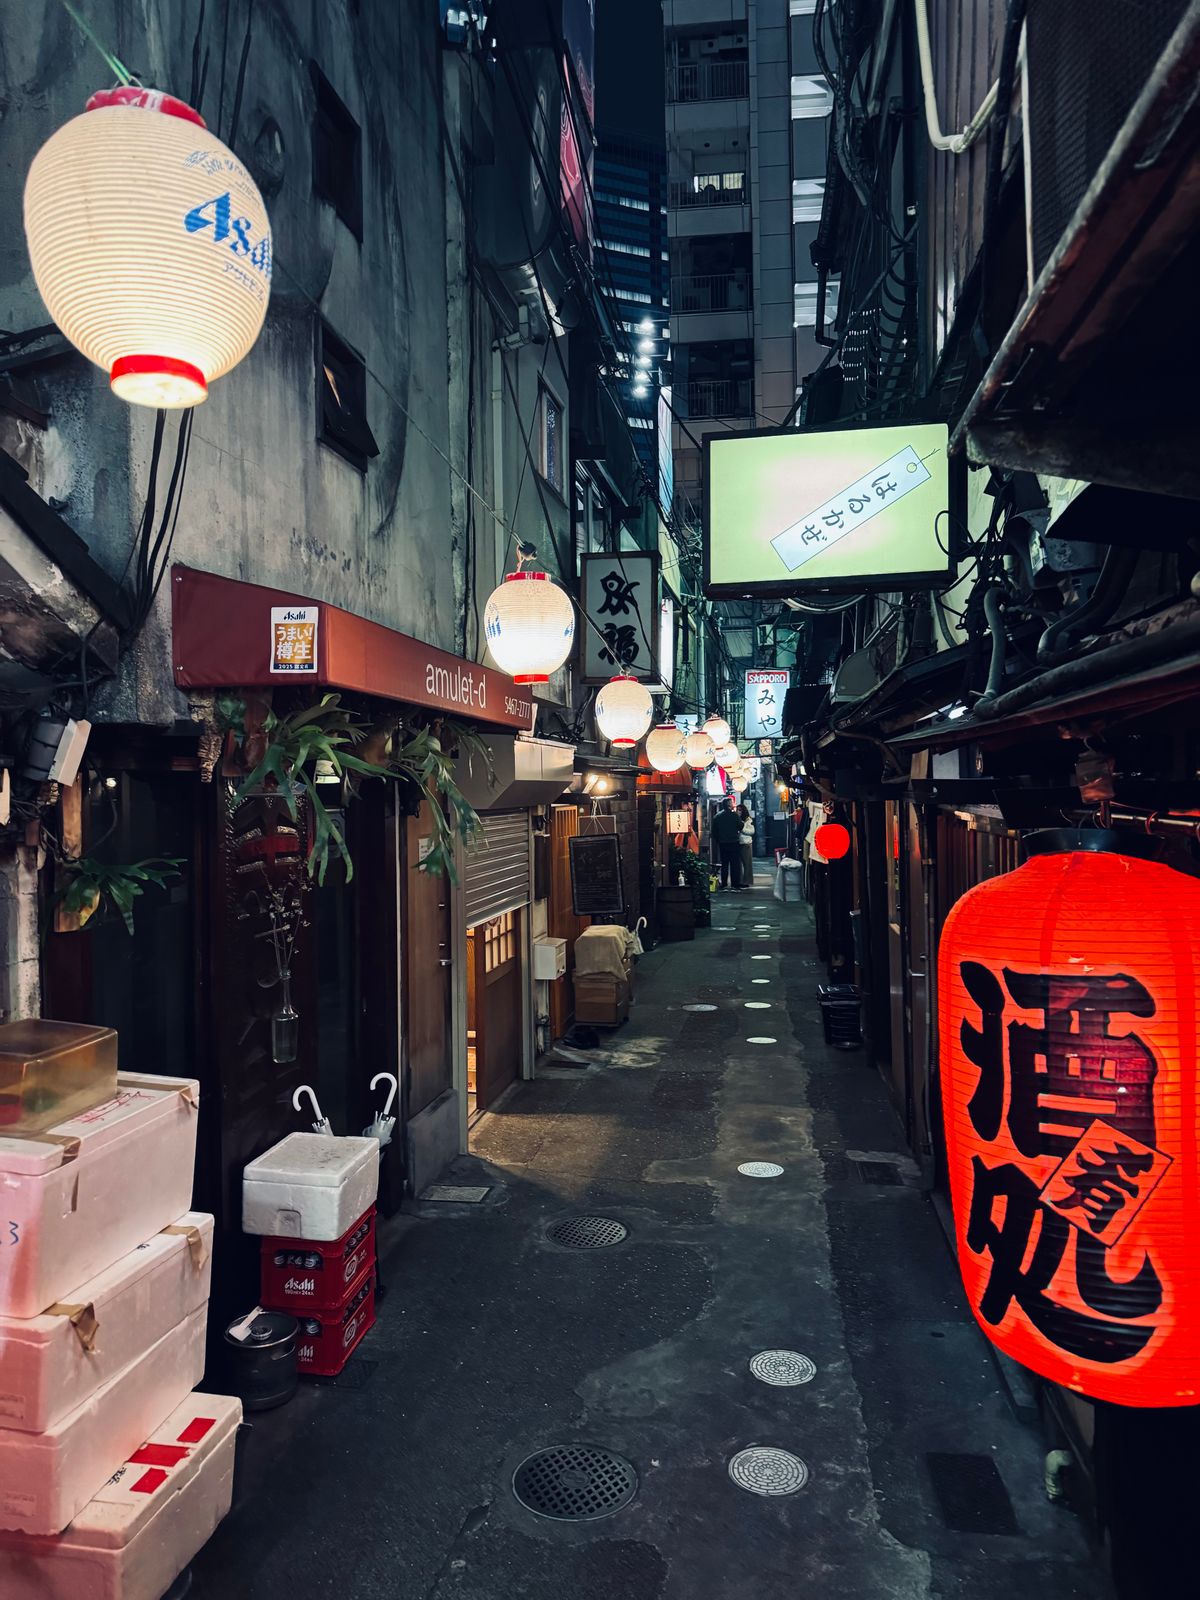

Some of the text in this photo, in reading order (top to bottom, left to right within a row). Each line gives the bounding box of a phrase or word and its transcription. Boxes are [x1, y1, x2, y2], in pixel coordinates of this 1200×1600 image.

[183, 191, 271, 279] Asa
[799, 471, 898, 546] はるかぜ
[284, 611, 306, 620] Asahi
[276, 641, 312, 660] 樽生
[425, 663, 486, 709] amulet-d
[504, 696, 531, 720] 5467-2777
[757, 689, 777, 732] みや
[959, 960, 1163, 1364] 酒処
[1048, 1140, 1155, 1235] 肴
[284, 1277, 315, 1291] Asahi
[298, 1345, 314, 1358] ahi
